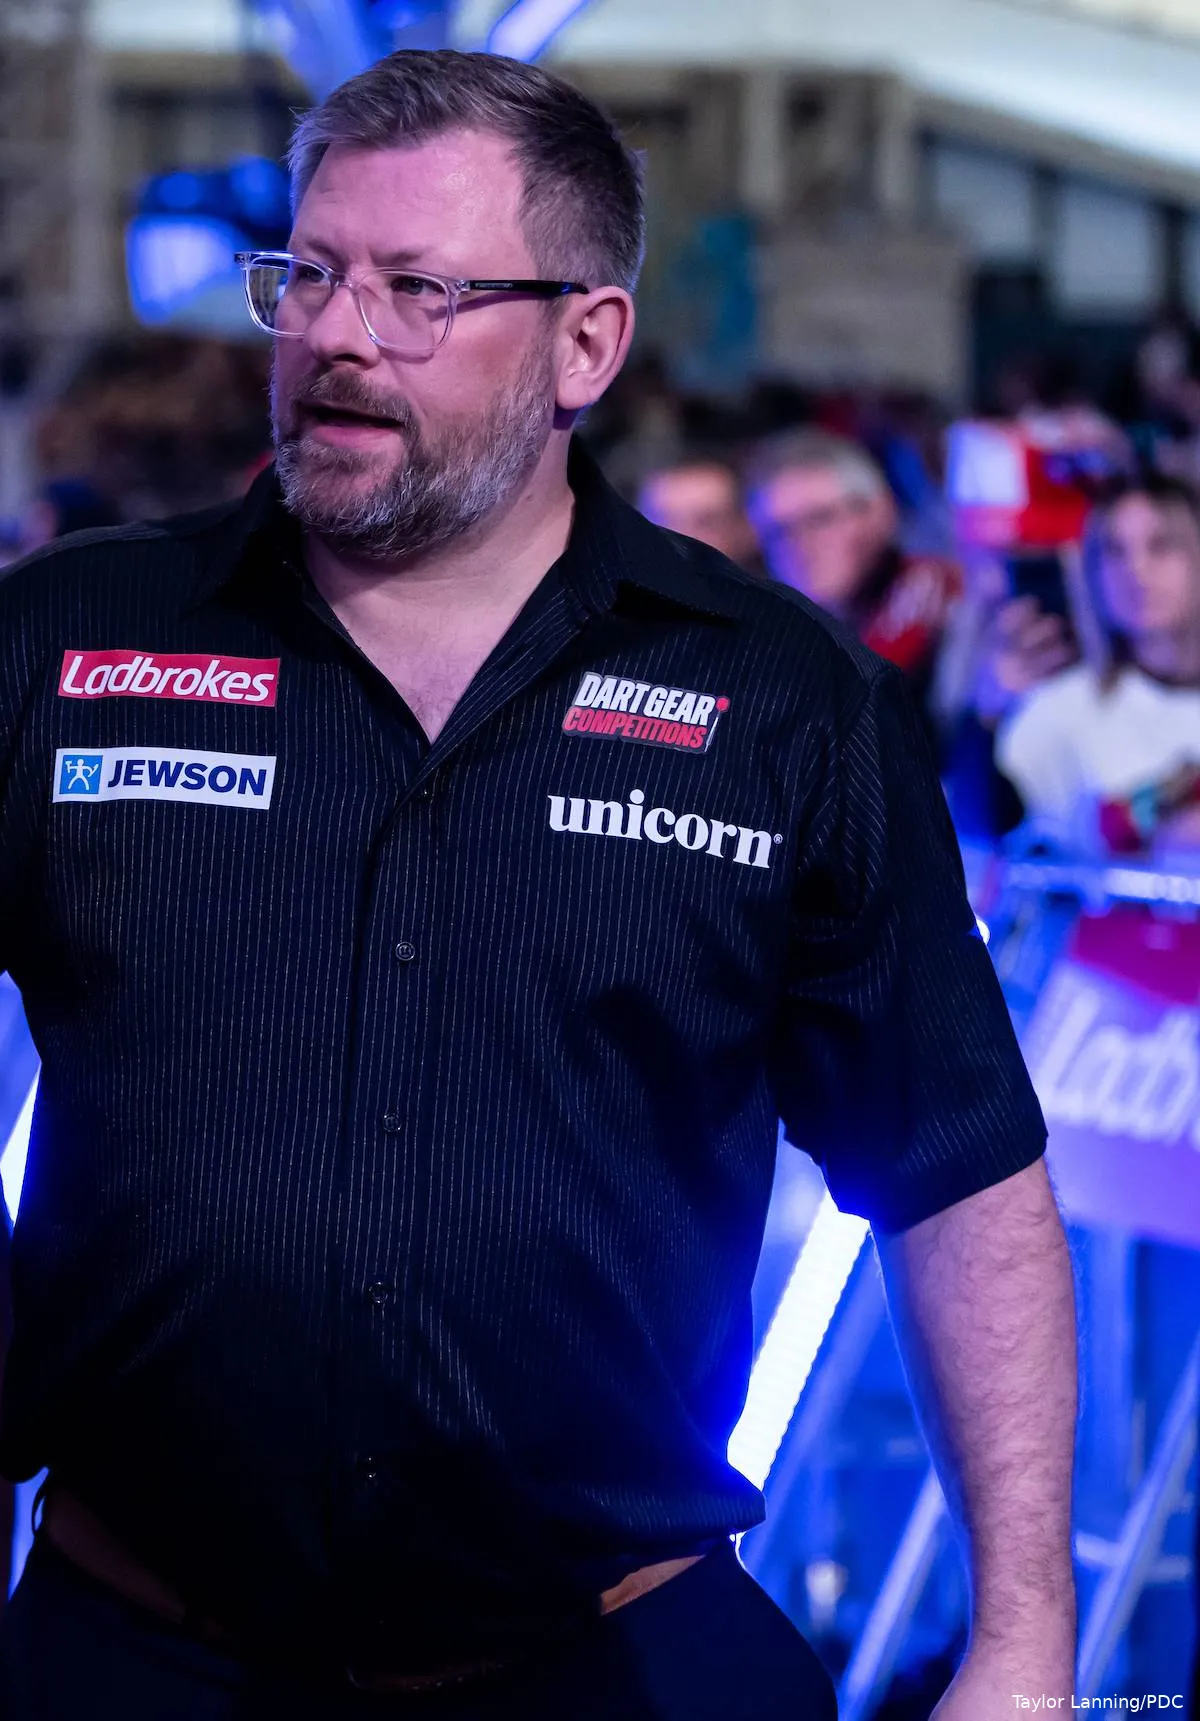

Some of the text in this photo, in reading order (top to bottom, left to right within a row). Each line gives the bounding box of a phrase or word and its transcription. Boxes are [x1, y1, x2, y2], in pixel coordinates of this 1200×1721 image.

[62, 655, 274, 702] Ladbrokes
[563, 706, 708, 748] COMPETITIONS
[107, 759, 267, 796] JEWSON
